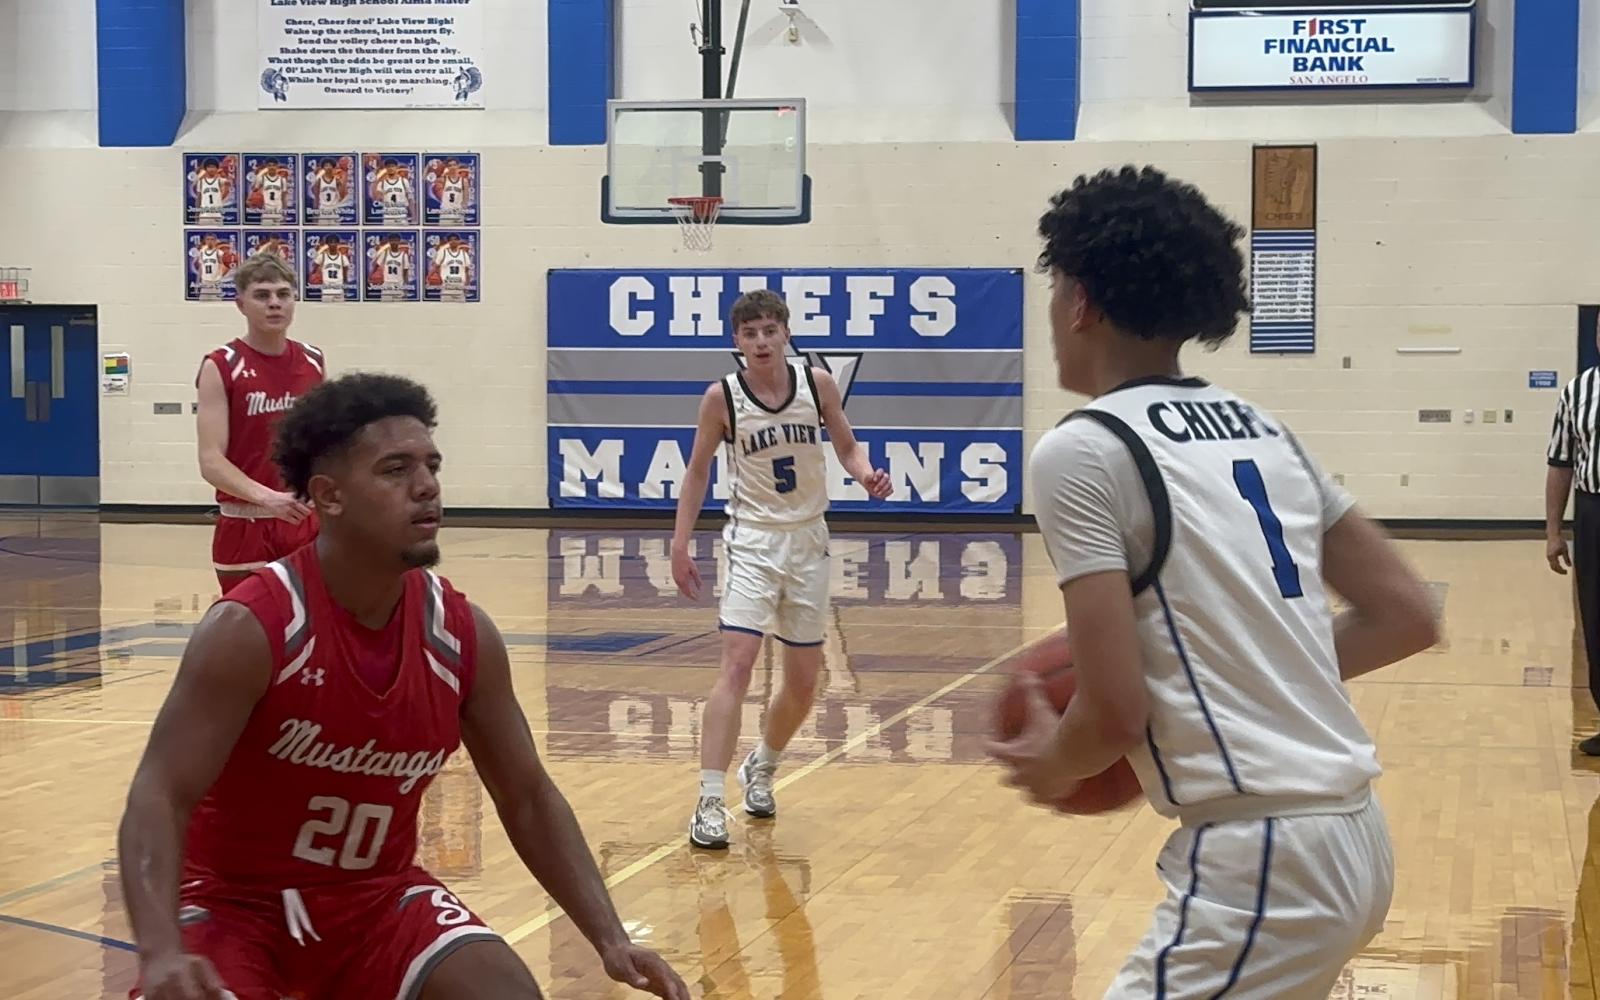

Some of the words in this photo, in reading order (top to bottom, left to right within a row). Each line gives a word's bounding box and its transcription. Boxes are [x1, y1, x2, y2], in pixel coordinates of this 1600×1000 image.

[428, 18, 454, 26] High!
[1293, 18, 1367, 37] FIRST
[1264, 37, 1395, 54] FINANCIAL
[294, 57, 328, 65] though
[387, 57, 413, 65] great
[442, 57, 474, 65] small,
[1293, 56, 1364, 72] BANK
[349, 67, 372, 75] High
[1289, 76, 1315, 85] SAN
[1319, 75, 1369, 84] ANGELO
[335, 77, 358, 85] loyal
[609, 276, 957, 337] CHEFS
[741, 425, 778, 457] LAKE
[781, 423, 817, 446] VIEW
[772, 456, 797, 494] 5
[1232, 458, 1304, 599] 1
[268, 718, 446, 794] Mustangs
[291, 795, 394, 870] 20
